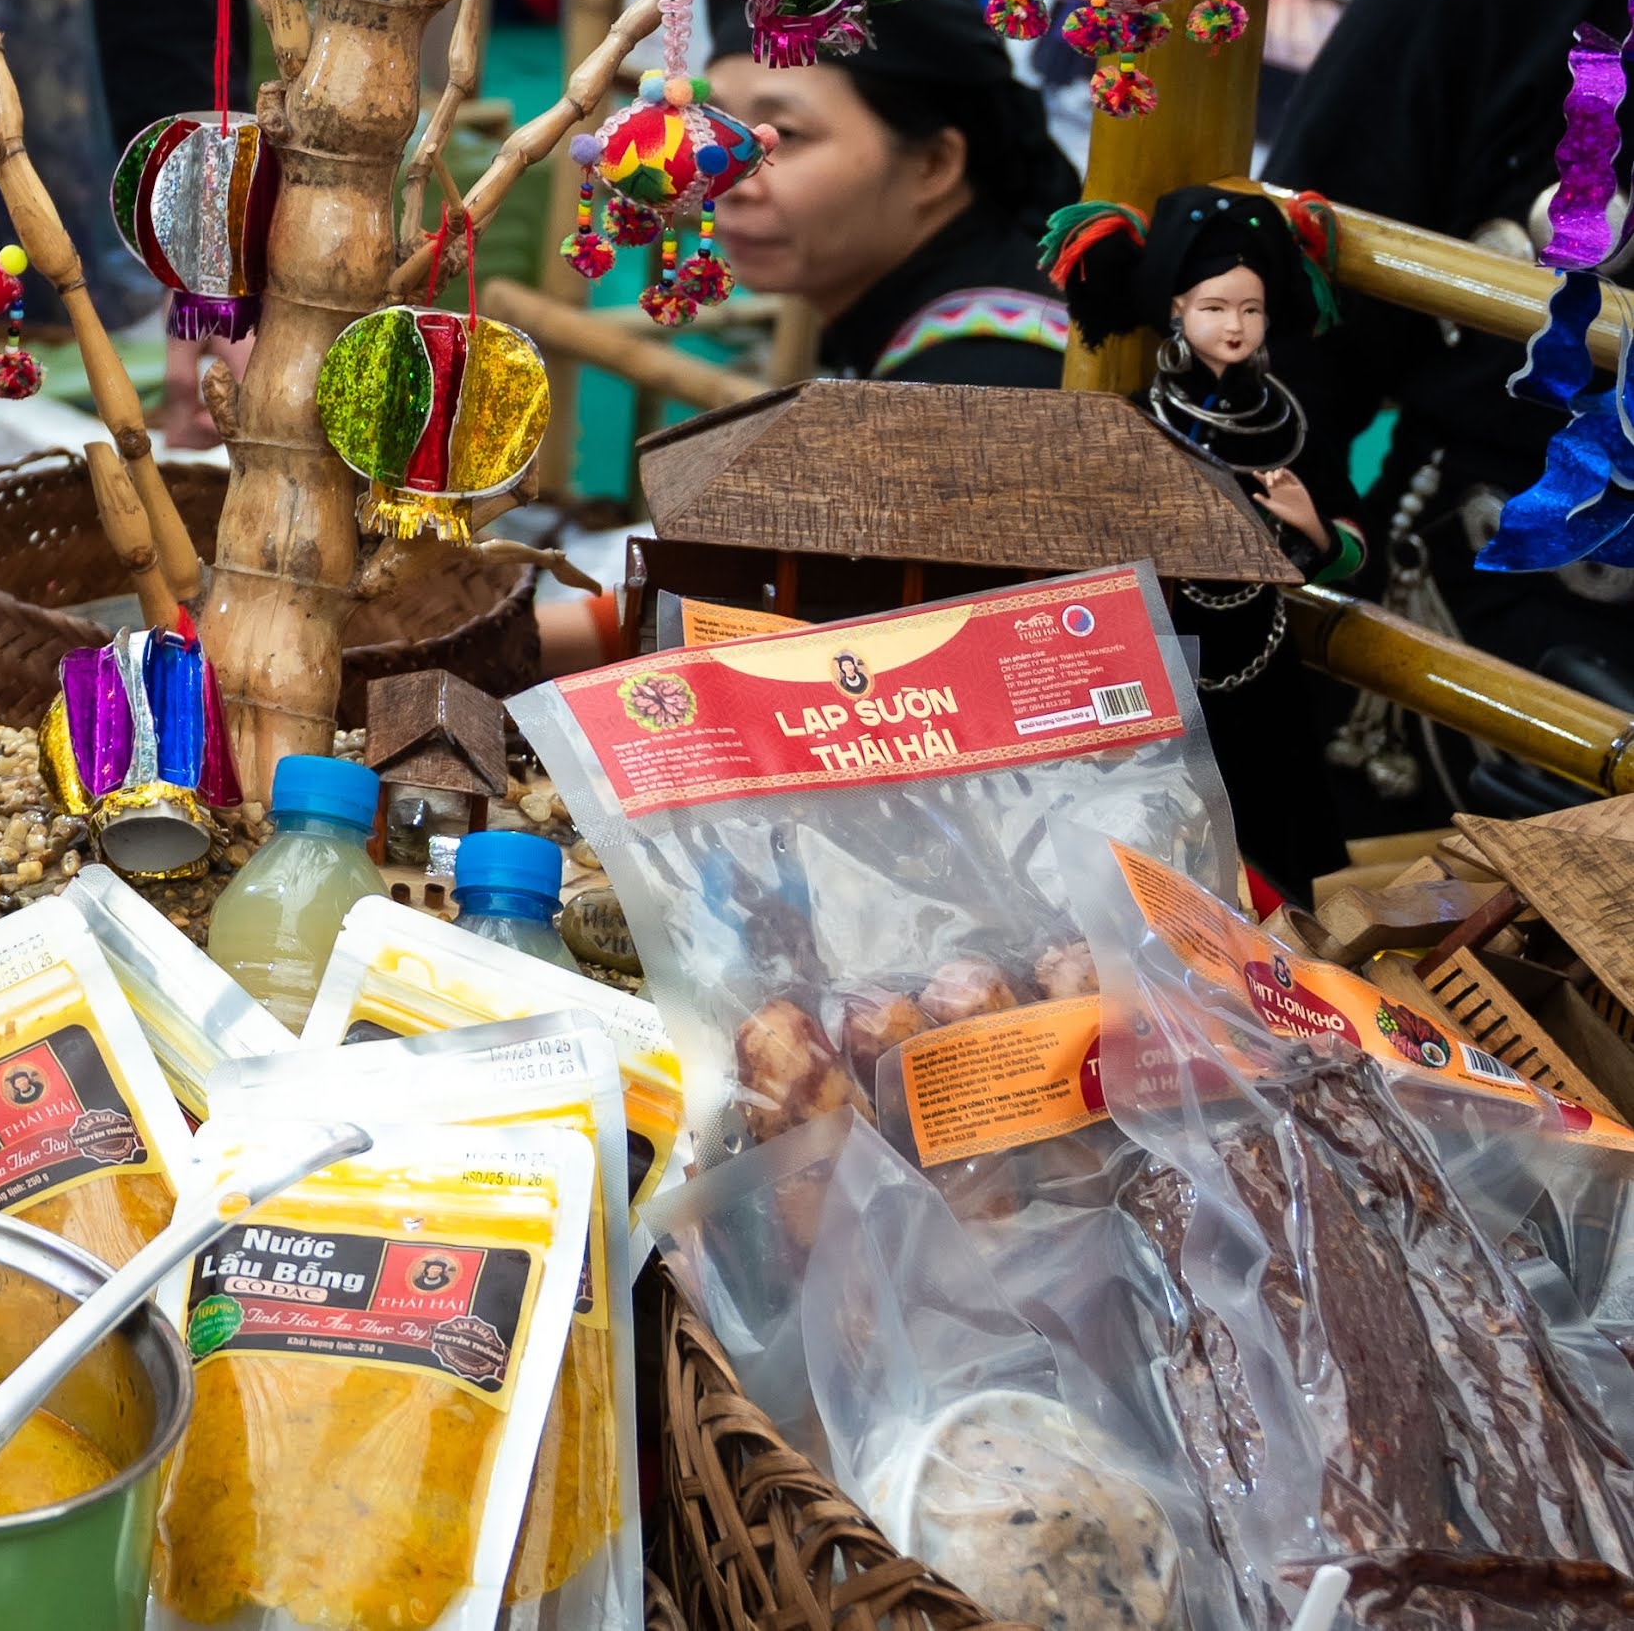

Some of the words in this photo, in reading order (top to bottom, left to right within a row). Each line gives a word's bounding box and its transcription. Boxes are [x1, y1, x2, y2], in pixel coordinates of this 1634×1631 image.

[774, 704, 849, 739] LẠP
[854, 686, 959, 727] SƯỜN
[809, 733, 895, 770] THÁI
[893, 720, 958, 762] HẢI
[6, 1149, 41, 1170] Thực
[26, 1173, 43, 1189] 250
[241, 1228, 336, 1259] Nước
[200, 1250, 262, 1279] Lẩu
[271, 1261, 366, 1294] Bỗng
[244, 1307, 280, 1324] Tinh
[282, 1312, 318, 1328] Hoa
[356, 1319, 395, 1337] Thực
